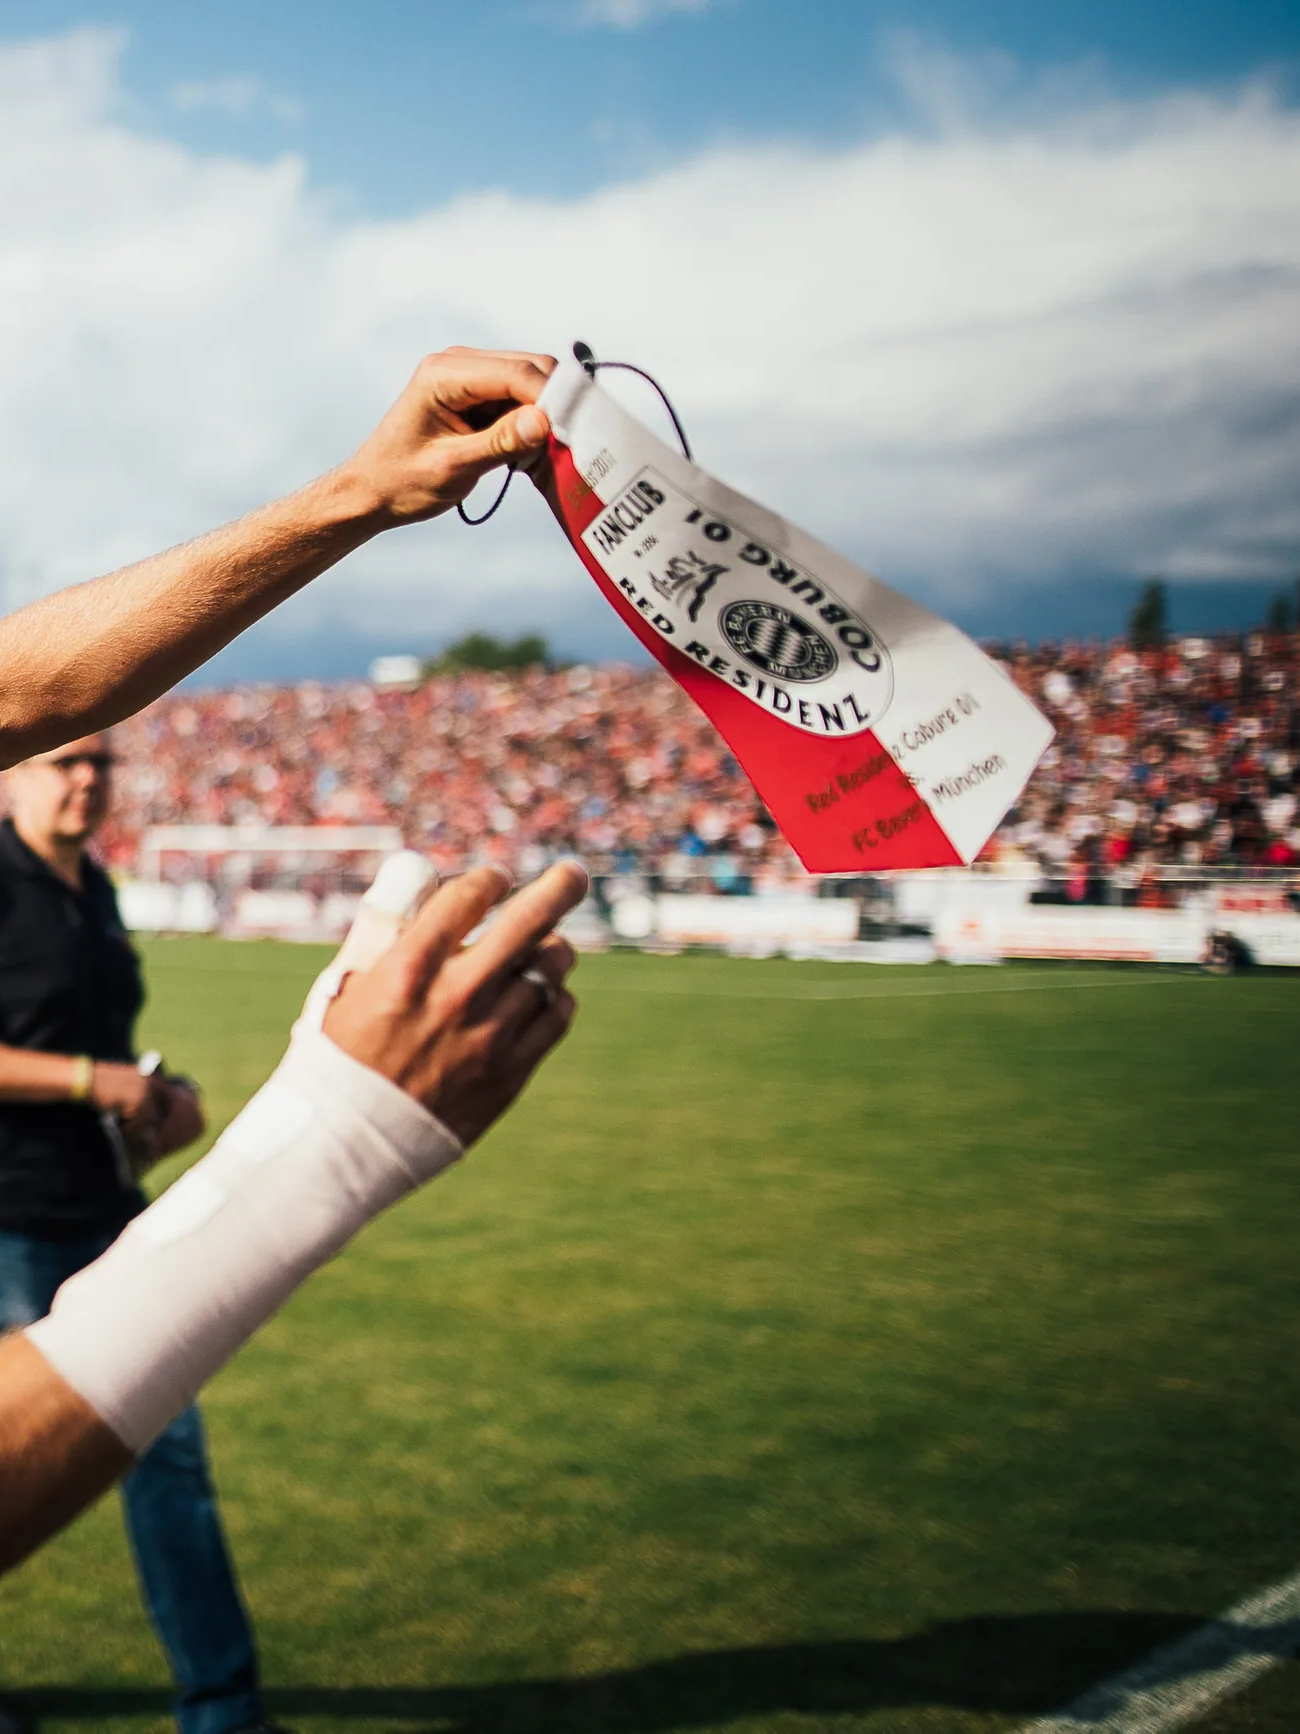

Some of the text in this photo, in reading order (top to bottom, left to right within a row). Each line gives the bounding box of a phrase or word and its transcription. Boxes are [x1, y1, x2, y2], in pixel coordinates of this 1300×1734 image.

[592, 480, 666, 555] FANCLUB
[619, 577, 675, 635] RED
[737, 542, 881, 673] COBURG
[684, 640, 870, 732] RESIDENZ
[805, 783, 840, 815] Red
[836, 744, 905, 796] Residenz
[903, 708, 959, 752] Coburg
[852, 754, 1007, 853] FC Bayern München
